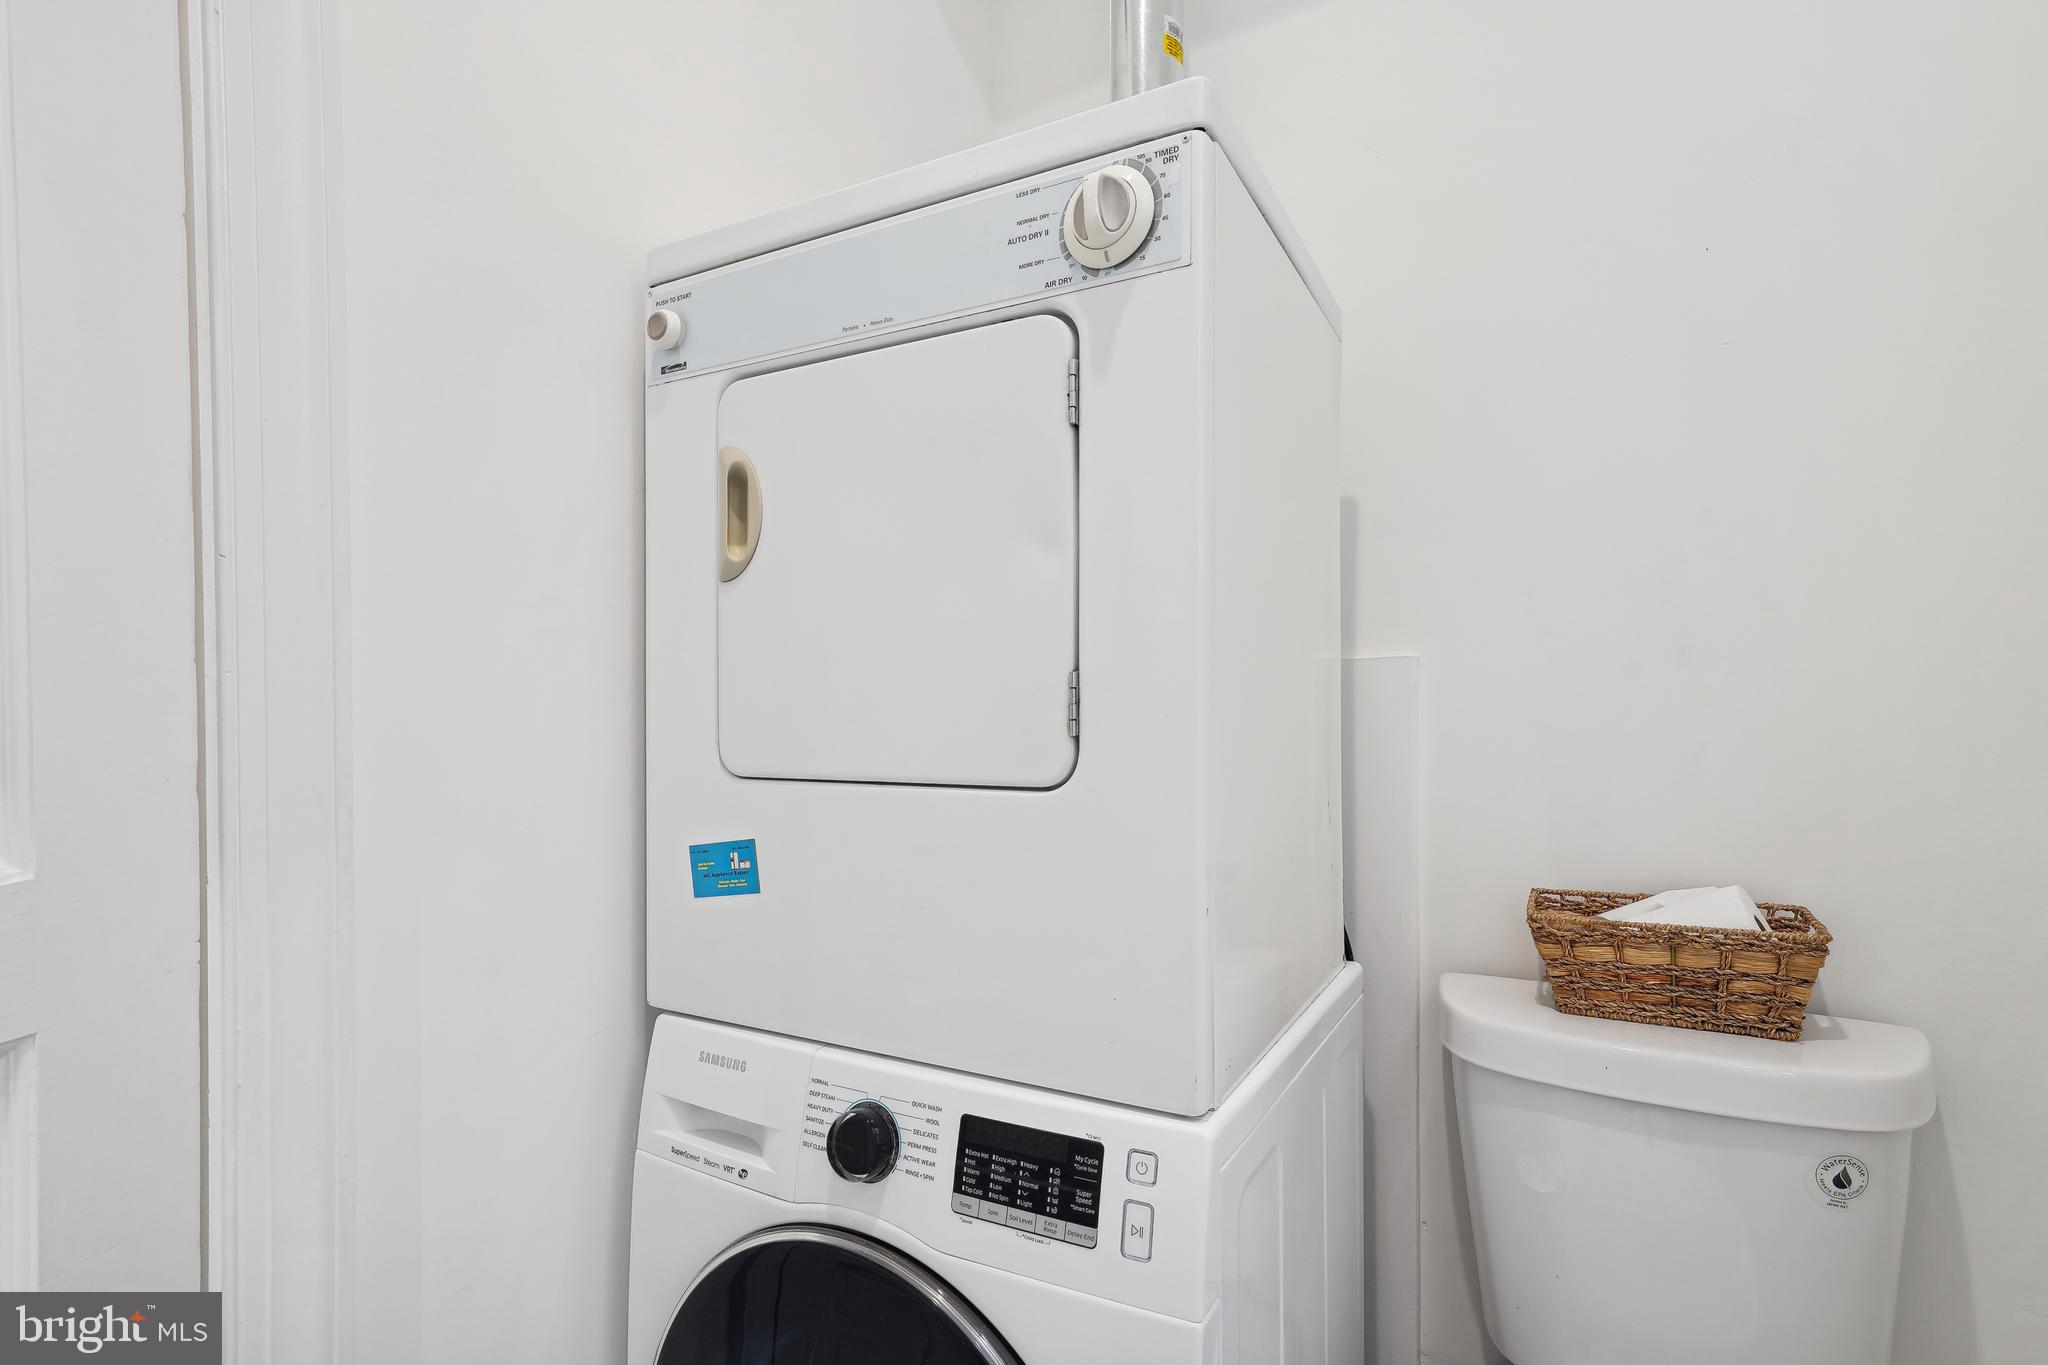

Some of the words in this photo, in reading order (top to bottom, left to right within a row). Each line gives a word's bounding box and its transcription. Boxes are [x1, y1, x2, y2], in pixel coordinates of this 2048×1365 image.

[1154, 145, 1179, 159] TIMED
[1162, 154, 1179, 165] DRY
[1016, 190, 1028, 199] LESS
[1028, 187, 1041, 195] DRY
[1016, 216, 1038, 226] NORMAL
[1038, 213, 1050, 222] DRY
[1007, 234, 1027, 246] AUTO
[1028, 231, 1044, 242] DRY
[1018, 262, 1033, 271] MORE
[1033, 259, 1045, 267] DRY
[1044, 279, 1057, 289] AIR
[1058, 276, 1073, 287] DRY
[655, 298, 669, 307] PUSH
[669, 296, 677, 304] TO
[676, 292, 692, 302] START
[841, 324, 859, 334] Portable
[870, 318, 883, 327] Heavy
[883, 315, 894, 324] Duty
[699, 1050, 747, 1073] SAMSUNG
[811, 1077, 829, 1087] NORMAL
[809, 1090, 821, 1098] DEEP
[821, 1093, 836, 1101] STEAM
[807, 1103, 822, 1112] HEAVY
[822, 1106, 834, 1114] DUTY
[911, 1101, 927, 1109] QUICK
[927, 1103, 942, 1112] WASH
[805, 1115, 825, 1125] SANITIZE
[925, 1117, 940, 1127] WOOL
[913, 1129, 939, 1141] DELICATES
[802, 1140, 812, 1148] SELF
[812, 1143, 827, 1152] CLEAN
[907, 1141, 922, 1150] PERM
[922, 1145, 937, 1154] PRESS
[671, 1146, 700, 1162] SuperSpeed
[703, 1157, 720, 1169] Steam
[968, 1149, 980, 1157] Extra
[903, 1154, 920, 1164] ACTIVE
[921, 1159, 936, 1168] WEAR
[1007, 1158, 1017, 1166] High
[1075, 1155, 1084, 1163] My
[1084, 1156, 1099, 1165] Cycle
[1024, 1162, 1039, 1171] Heavy
[1087, 1166, 1098, 1174] Save
[1820, 1159, 1865, 1177] WaterSense
[994, 1174, 1012, 1183] Medium
[1022, 1181, 1039, 1190] Normal
[1076, 1189, 1092, 1198] Super
[959, 1201, 972, 1210] Temp
[1020, 1200, 1032, 1208] Light
[1075, 1196, 1092, 1206] Speed
[987, 1209, 999, 1217] Spin
[1085, 1207, 1095, 1215] Care
[1009, 1214, 1019, 1222] Soil
[1019, 1217, 1033, 1225] Level
[1044, 1220, 1057, 1229] Extra
[1043, 1226, 1057, 1235] Rinse
[1067, 1229, 1083, 1239] Delay
[1084, 1233, 1095, 1242] End
